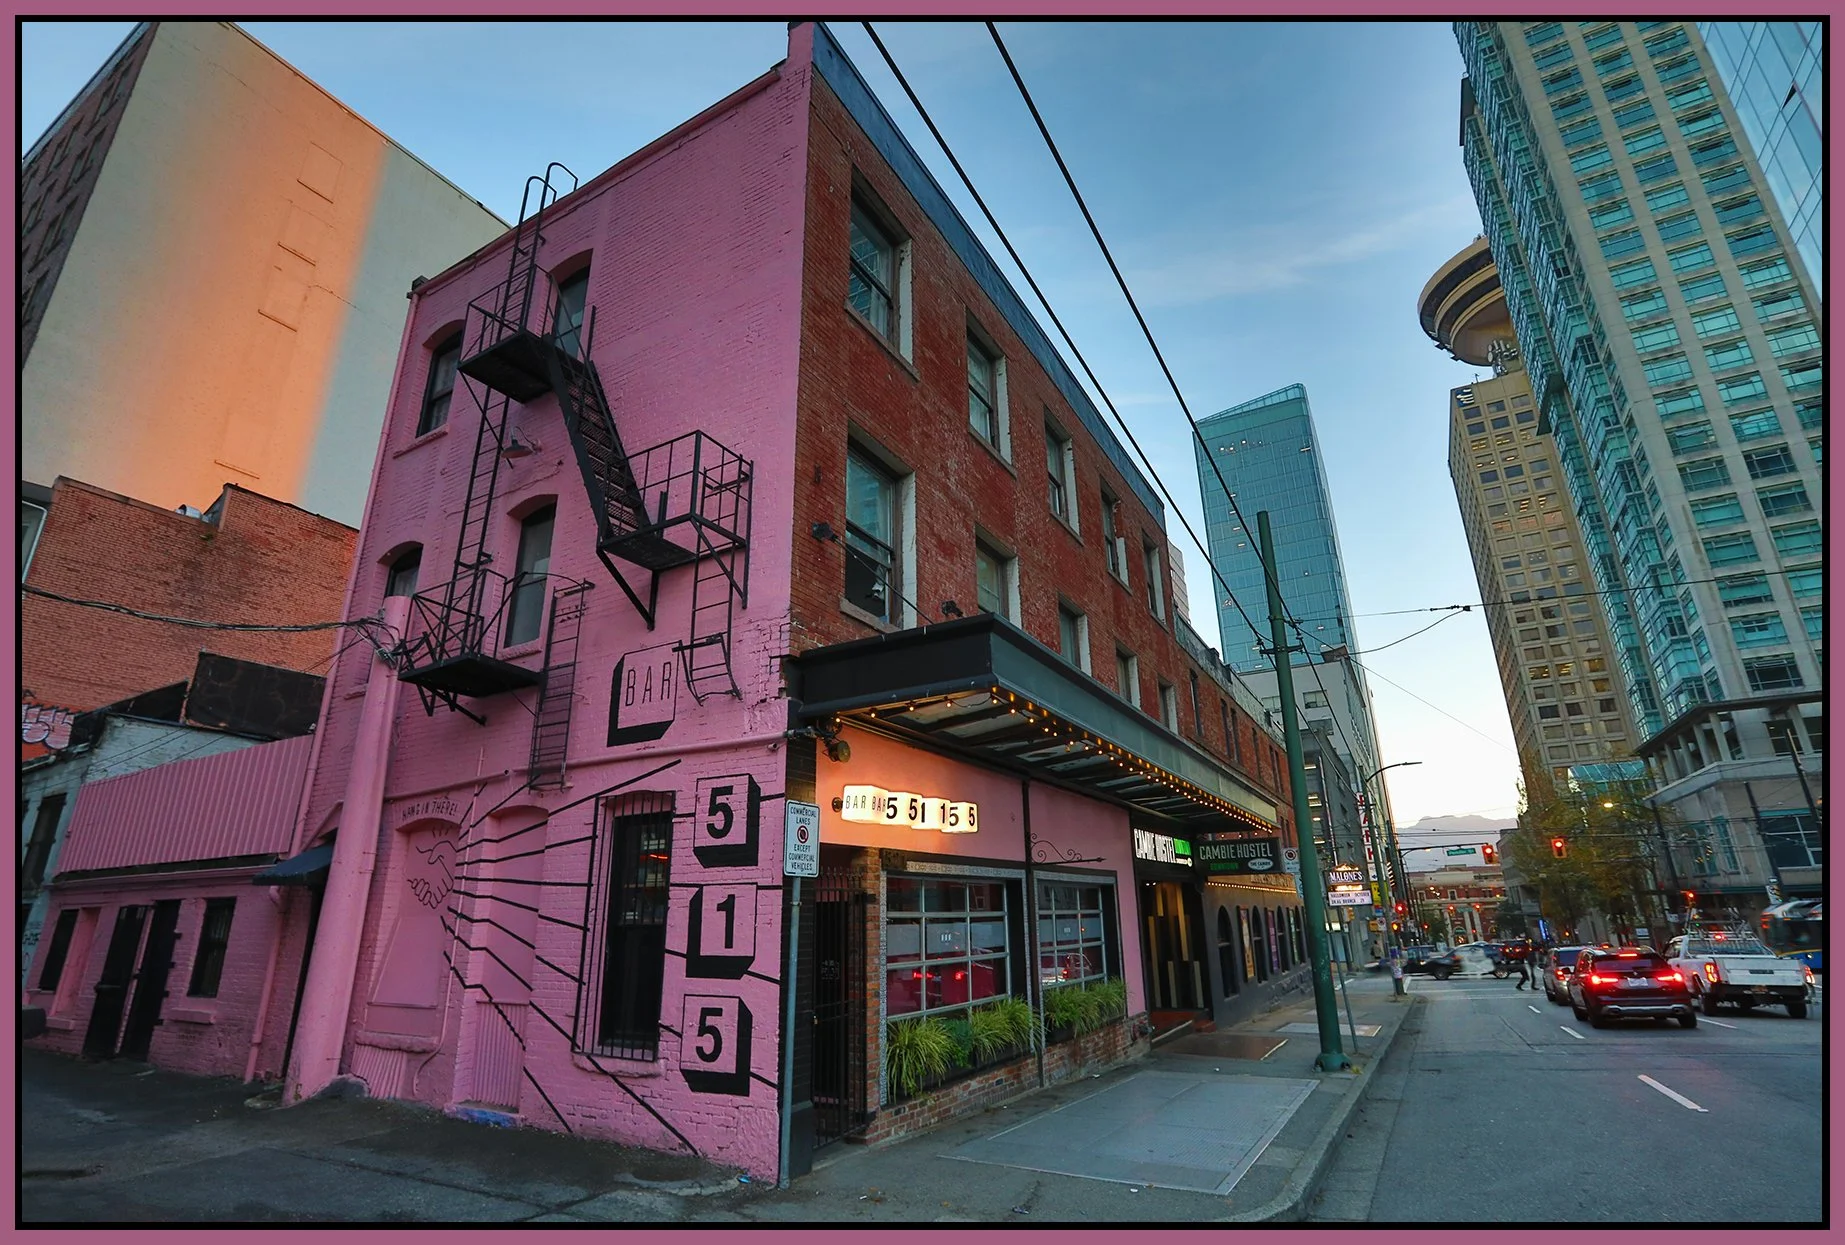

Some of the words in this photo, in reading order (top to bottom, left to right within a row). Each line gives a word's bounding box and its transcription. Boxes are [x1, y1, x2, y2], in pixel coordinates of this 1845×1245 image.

[625, 662, 671, 706] BAR
[845, 795, 866, 809] BAR
[705, 785, 734, 839] 5
[790, 806, 816, 818] COMMERCIAL
[796, 816, 811, 825] LANES
[794, 844, 811, 853] EXCEPT
[1200, 844, 1236, 860] CAMBIE
[1237, 842, 1273, 858] HOSTEL
[789, 852, 815, 863] COMMERCIAL
[791, 862, 813, 871] VEHICLES
[717, 894, 736, 949] 1
[696, 1007, 723, 1063] 5
